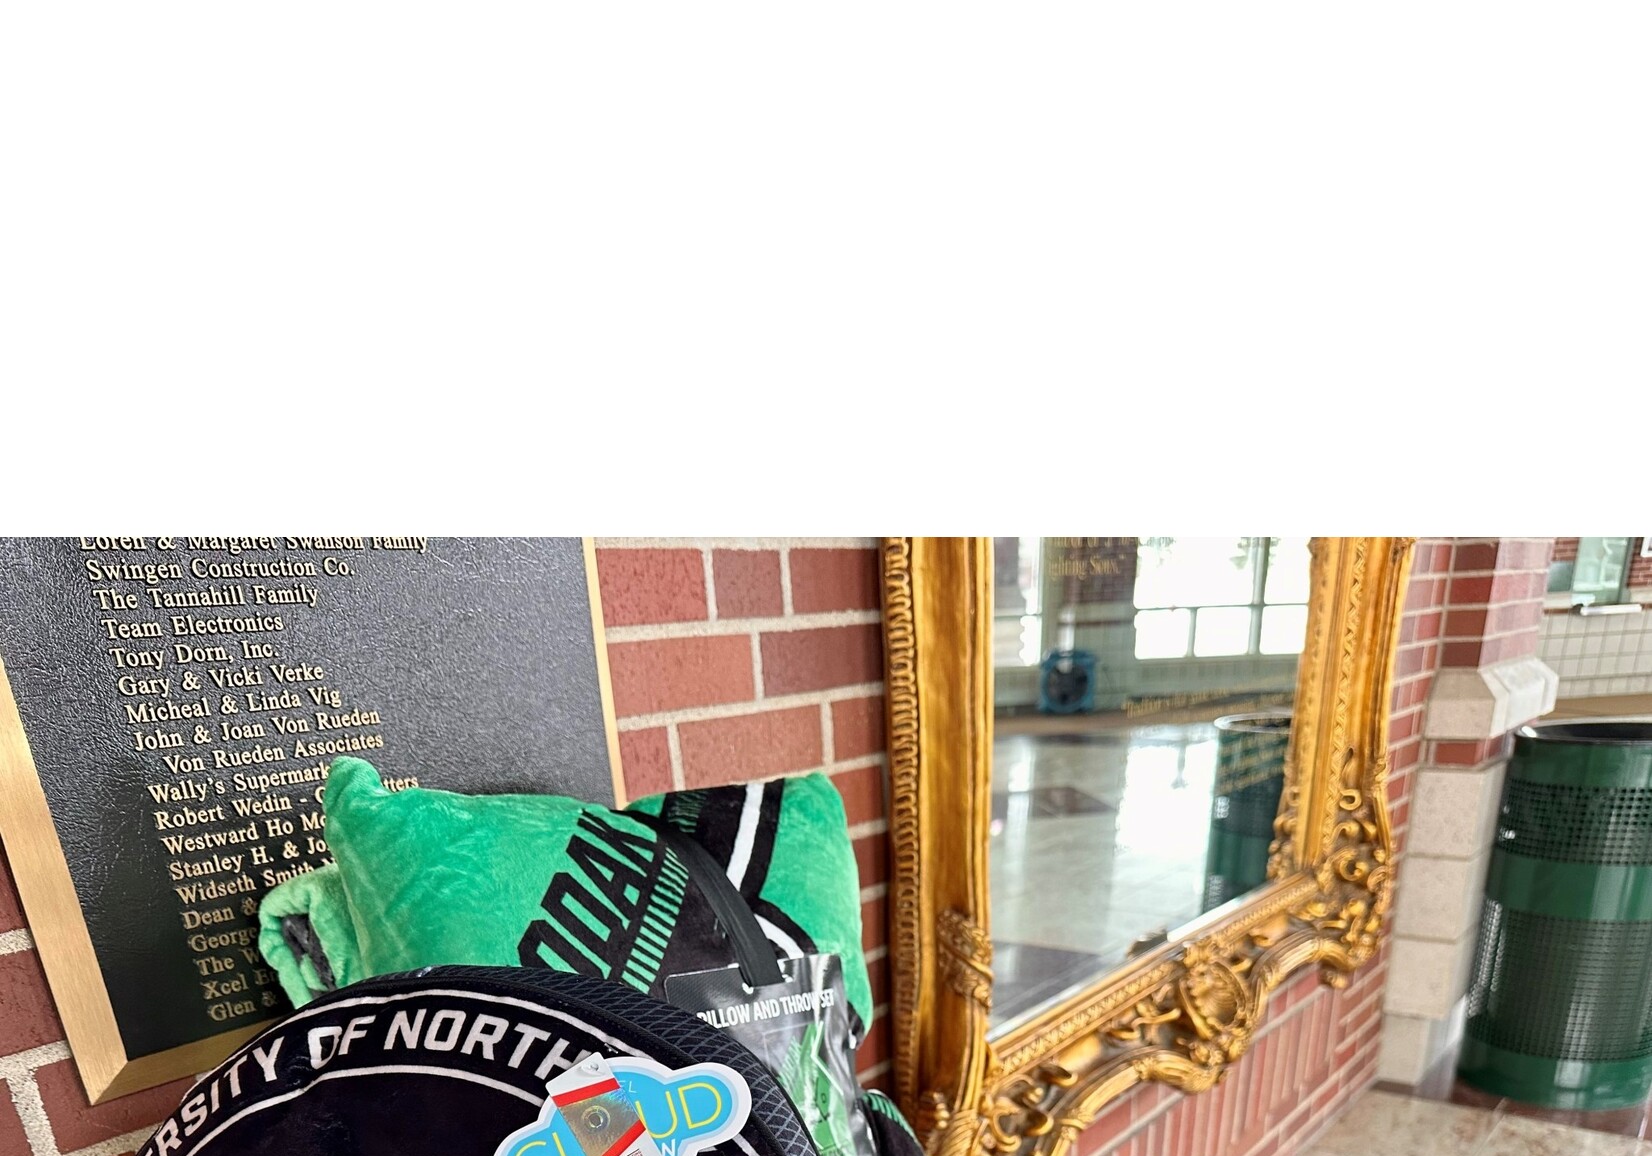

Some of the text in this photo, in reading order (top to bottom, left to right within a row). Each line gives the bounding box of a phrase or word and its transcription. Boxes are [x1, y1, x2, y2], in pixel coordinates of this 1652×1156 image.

[79, 536, 428, 555] Loren & Margaret Swanson Family
[86, 557, 355, 584] Swingen Construction Co.
[92, 584, 318, 610] The Tannahill Family
[101, 611, 284, 640] Team Electronics
[109, 640, 279, 670] Tony Dorn, Inc.
[118, 663, 324, 698] Gary & Vicki Verke
[124, 686, 342, 725] Micheal & Linda Vig
[133, 708, 382, 752] John & Joan Von Rueden
[162, 734, 385, 775] Von Rueden Associates
[147, 762, 332, 804] Wally's Supermark
[154, 804, 226, 831] Robert
[231, 793, 293, 818] Wedin
[160, 822, 259, 855] Westward
[265, 820, 294, 838] Ho
[168, 855, 244, 881] Stanley
[250, 846, 275, 865] H.
[282, 841, 300, 859] &
[174, 873, 257, 905] Widseth
[181, 897, 258, 930] Dean &
[188, 927, 258, 952] George
[195, 956, 236, 976] The
[201, 974, 249, 1000] Xcel
[208, 998, 257, 1022] Glen
[753, 998, 780, 1021] AND
[308, 1015, 376, 1069] OF
[385, 1009, 593, 1080] NORTH
